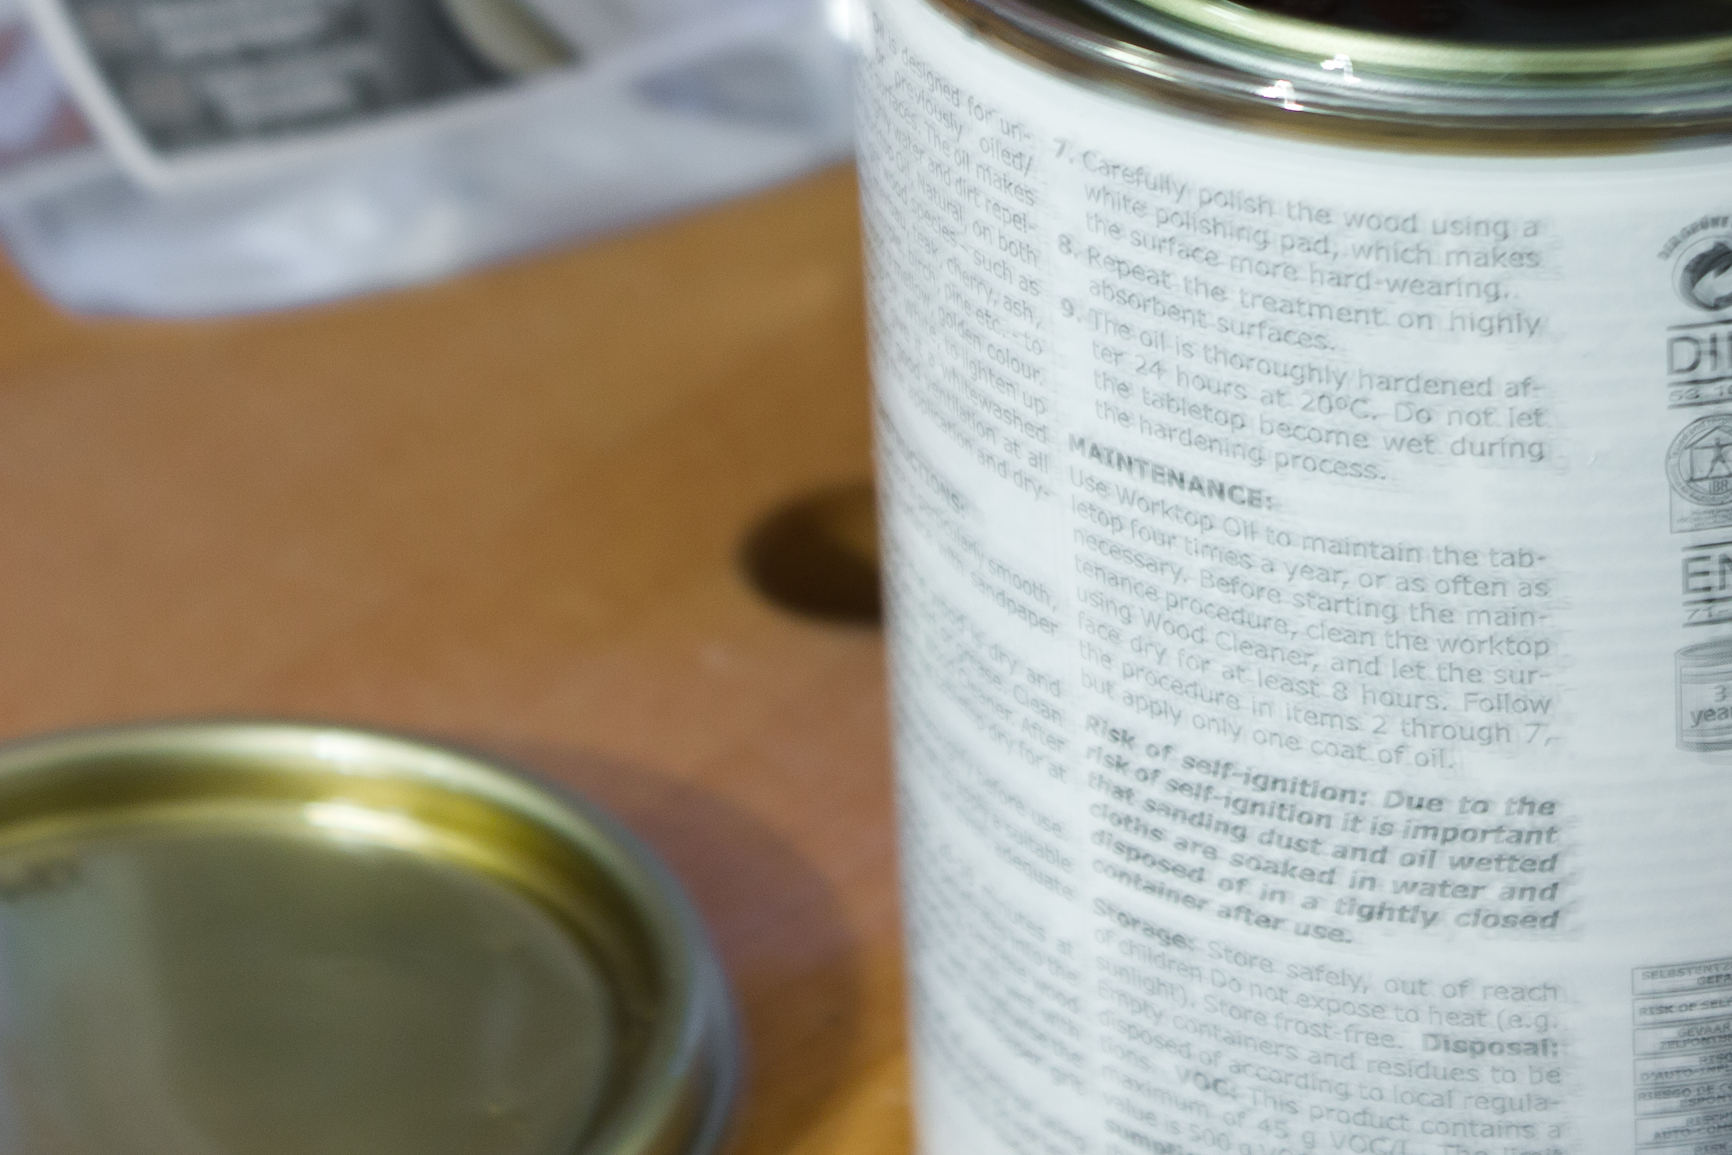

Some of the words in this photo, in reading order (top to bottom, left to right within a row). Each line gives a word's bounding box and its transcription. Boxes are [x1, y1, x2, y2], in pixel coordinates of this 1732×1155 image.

[1052, 139, 1073, 166] 7.
[1082, 149, 1186, 203] Carefully
[1198, 186, 1273, 215] polish
[1286, 199, 1330, 224] the
[1343, 210, 1417, 233] wood
[1432, 215, 1509, 243] using
[1523, 222, 1537, 238] a
[1084, 183, 1147, 218] white
[1155, 206, 1270, 250] polishing
[1280, 231, 1338, 260] pad,
[1351, 238, 1431, 264] which
[1445, 246, 1540, 269] makes
[1057, 233, 1078, 261] 8.
[1087, 245, 1171, 289] Repeat
[1183, 274, 1226, 302] the
[1239, 286, 1380, 325] treatment
[1398, 312, 1431, 330] on
[1449, 310, 1540, 340] highly
[1086, 212, 1121, 242] the
[1130, 230, 1218, 266] surface
[1230, 254, 1298, 281] more
[1309, 262, 1509, 304] hard-wearing.
[1060, 297, 1081, 324] 9.
[1091, 308, 1130, 340] The
[1139, 326, 1165, 350] oil
[1176, 333, 1192, 357] is
[1204, 342, 1345, 390] thoroughly
[1359, 366, 1491, 397] hardened
[1505, 377, 1543, 398] af-
[1089, 279, 1206, 327] absorbent
[1216, 315, 1336, 350] surfaces.
[1092, 340, 1123, 368] ter
[1135, 352, 1164, 380] 24
[1176, 363, 1247, 399] hours
[1260, 386, 1287, 407] at
[1393, 400, 1431, 424] Do
[1447, 408, 1492, 428] not
[1509, 407, 1543, 429] let
[1093, 370, 1129, 400] the
[1141, 385, 1245, 434] tabletop
[1259, 412, 1368, 448] become
[1383, 434, 1434, 455] wet
[1450, 435, 1544, 465] during
[1068, 432, 1272, 510] MAINTENANCE:
[1069, 466, 1107, 499] Use
[1116, 483, 1213, 536] Worktop
[1223, 513, 1256, 540] Oil
[1266, 523, 1290, 546] to
[1302, 533, 1420, 563] maintain
[1432, 545, 1476, 567] the
[1489, 548, 1546, 569] tab-
[1071, 494, 1122, 538] letop
[1130, 516, 1176, 549] four
[1185, 534, 1251, 567] times
[1260, 554, 1273, 572] a
[1286, 559, 1347, 589] year,
[1359, 570, 1384, 589] or
[1395, 574, 1423, 592] as
[1435, 574, 1505, 597] often
[1518, 582, 1548, 598] as
[1073, 529, 1188, 584] necessary.
[1199, 566, 1281, 604] Before
[1292, 589, 1397, 626] starting
[1409, 602, 1453, 625] the
[1467, 607, 1547, 629] main-
[1074, 555, 1157, 602] tenance
[1165, 590, 1296, 641] procedure,
[1306, 619, 1374, 647] clean
[1384, 629, 1427, 652] the
[1437, 635, 1550, 663] worktop
[1714, 684, 1728, 704] 3
[1085, 712, 1132, 750] Risk
[1145, 740, 1172, 764] of
[1182, 752, 1366, 805] self-ignition:
[1382, 787, 1442, 813] Due
[1458, 796, 1488, 816] to
[1504, 797, 1554, 818] the
[1086, 744, 1125, 776] risk
[1134, 764, 1160, 788] of
[1164, 775, 1331, 828] self-ignition
[1341, 810, 1363, 833] it
[1370, 814, 1392, 837] is
[1403, 818, 1557, 848] important
[1089, 801, 1162, 843] cloths
[1172, 832, 1217, 860] are
[1228, 848, 1334, 885] soaked
[1349, 867, 1376, 891] in
[1391, 878, 1485, 901] water
[1499, 882, 1556, 903] and
[1093, 894, 1195, 951] Storage:
[1207, 935, 1274, 972] Store
[1286, 959, 1368, 995] safely,
[1384, 976, 1428, 996] out
[1442, 978, 1468, 1000] of
[1482, 982, 1555, 1003] reach
